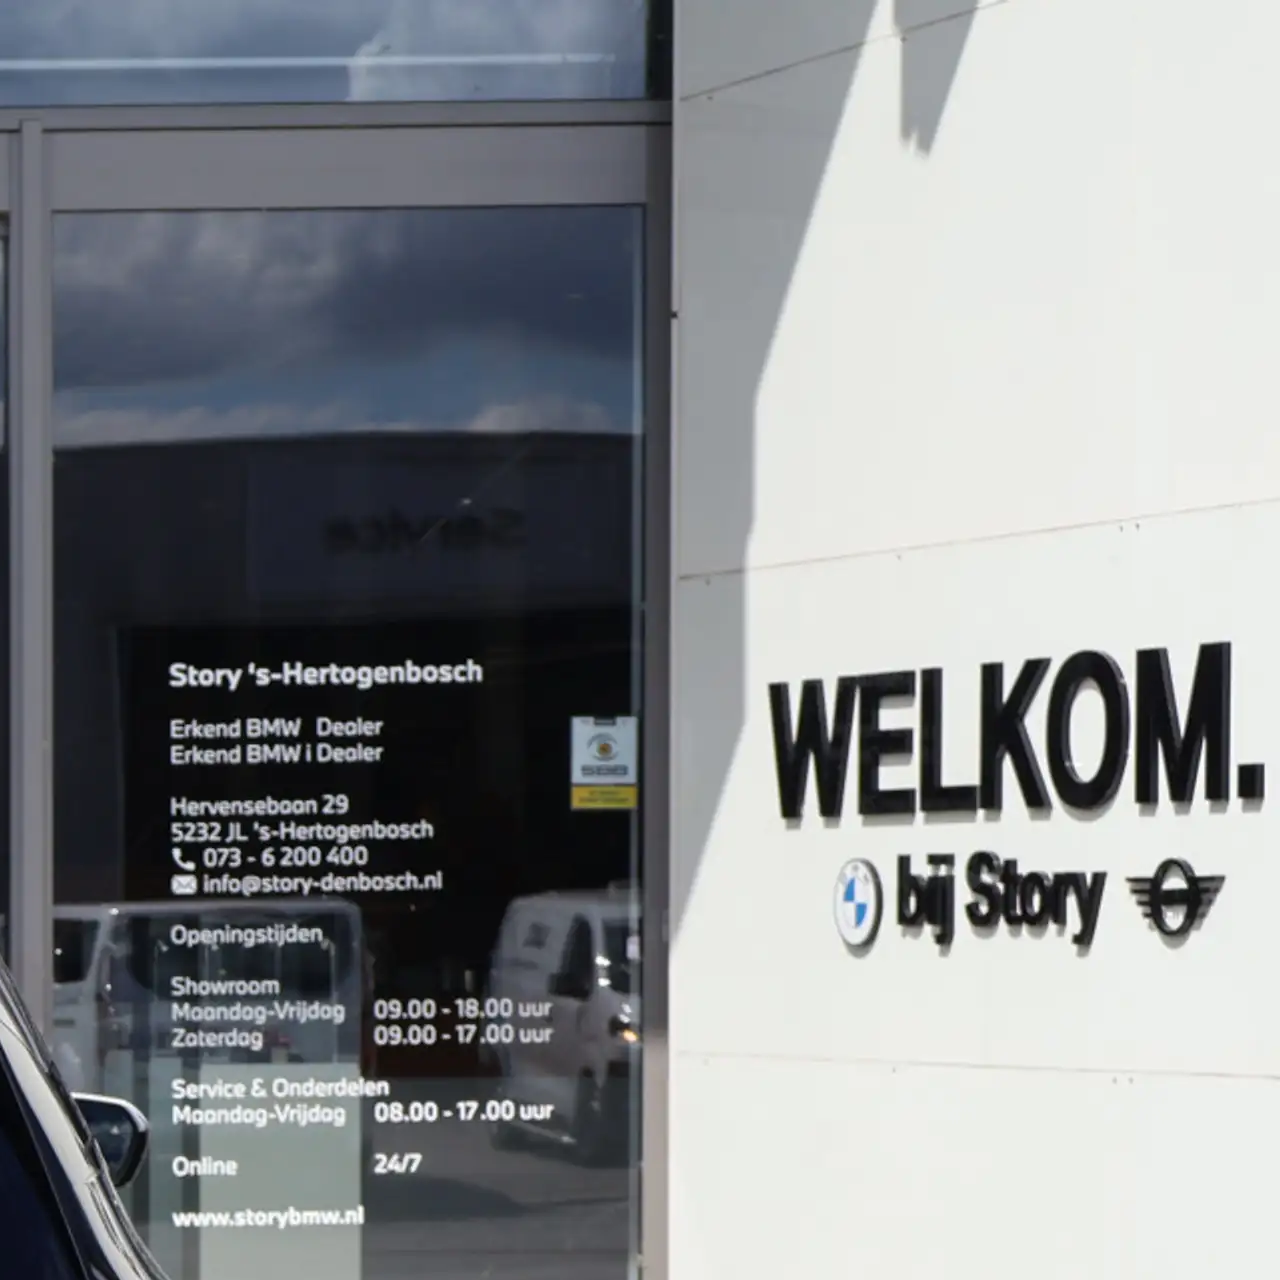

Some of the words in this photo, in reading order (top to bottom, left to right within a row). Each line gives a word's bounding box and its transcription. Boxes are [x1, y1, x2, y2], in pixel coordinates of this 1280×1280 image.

[169, 664, 241, 689] Story
[249, 660, 482, 688] 's-Hertogenbosch
[170, 720, 241, 738] Erkend
[246, 718, 300, 738] BMW
[317, 718, 383, 736] Dealer
[768, 641, 1265, 820] WELKOM.
[170, 746, 241, 764] Erkend
[246, 745, 300, 764] BMW
[305, 745, 312, 762] i
[317, 744, 383, 762] Dealer
[170, 797, 317, 816] Hervensebaan
[322, 795, 349, 814] 29
[171, 823, 221, 842] 5232
[226, 823, 248, 843] JL
[254, 819, 434, 844] 's-Hertogenbosch
[204, 848, 242, 867] 073
[262, 847, 275, 866] 6
[280, 847, 321, 866] 200
[326, 846, 368, 865] 400
[203, 871, 443, 896] info@story-denbosch.nl
[896, 854, 955, 946] bij
[965, 850, 1107, 946] Story
[170, 924, 323, 947] Openingstijden
[171, 976, 280, 996] Showroom
[171, 1001, 346, 1024] Maandag-Vrijdag
[374, 999, 435, 1020] 09.00
[456, 998, 513, 1019] 18.00
[519, 1000, 552, 1018] uur
[171, 1028, 263, 1049] Zaterdag
[374, 1024, 436, 1046] 09.00
[519, 1026, 553, 1043] uur
[172, 1079, 245, 1098] Service
[252, 1079, 267, 1097] &
[273, 1078, 390, 1097] Onderdelen
[172, 1103, 345, 1127] Maandag-Vrijdag
[374, 1102, 437, 1122] 08.00
[519, 1103, 553, 1120] uur
[172, 1156, 237, 1176] Online
[374, 1153, 421, 1174] 24/7
[172, 1206, 364, 1228] www.storybmw.nl
